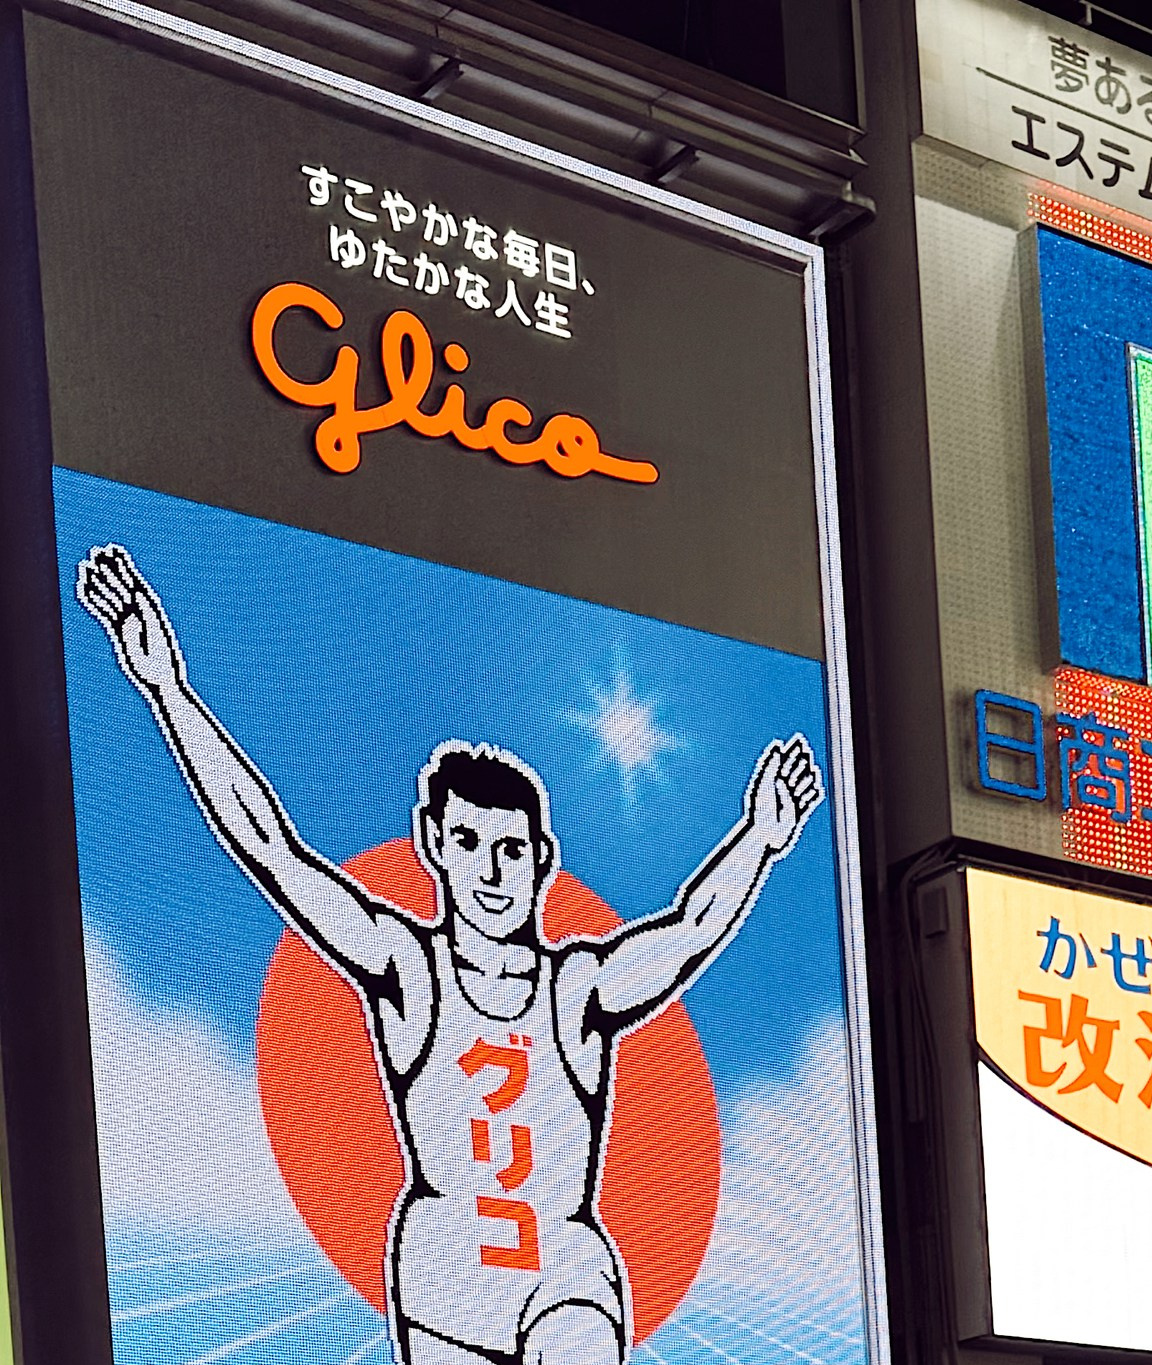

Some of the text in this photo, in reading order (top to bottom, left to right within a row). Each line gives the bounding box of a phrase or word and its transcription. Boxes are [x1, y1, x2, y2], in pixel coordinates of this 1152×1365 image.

[301, 163, 595, 295] すこやかな毎日、
[330, 225, 572, 339] ゆたかな人生
[252, 282, 660, 484] Glico
[458, 1032, 541, 1273] グリコ
